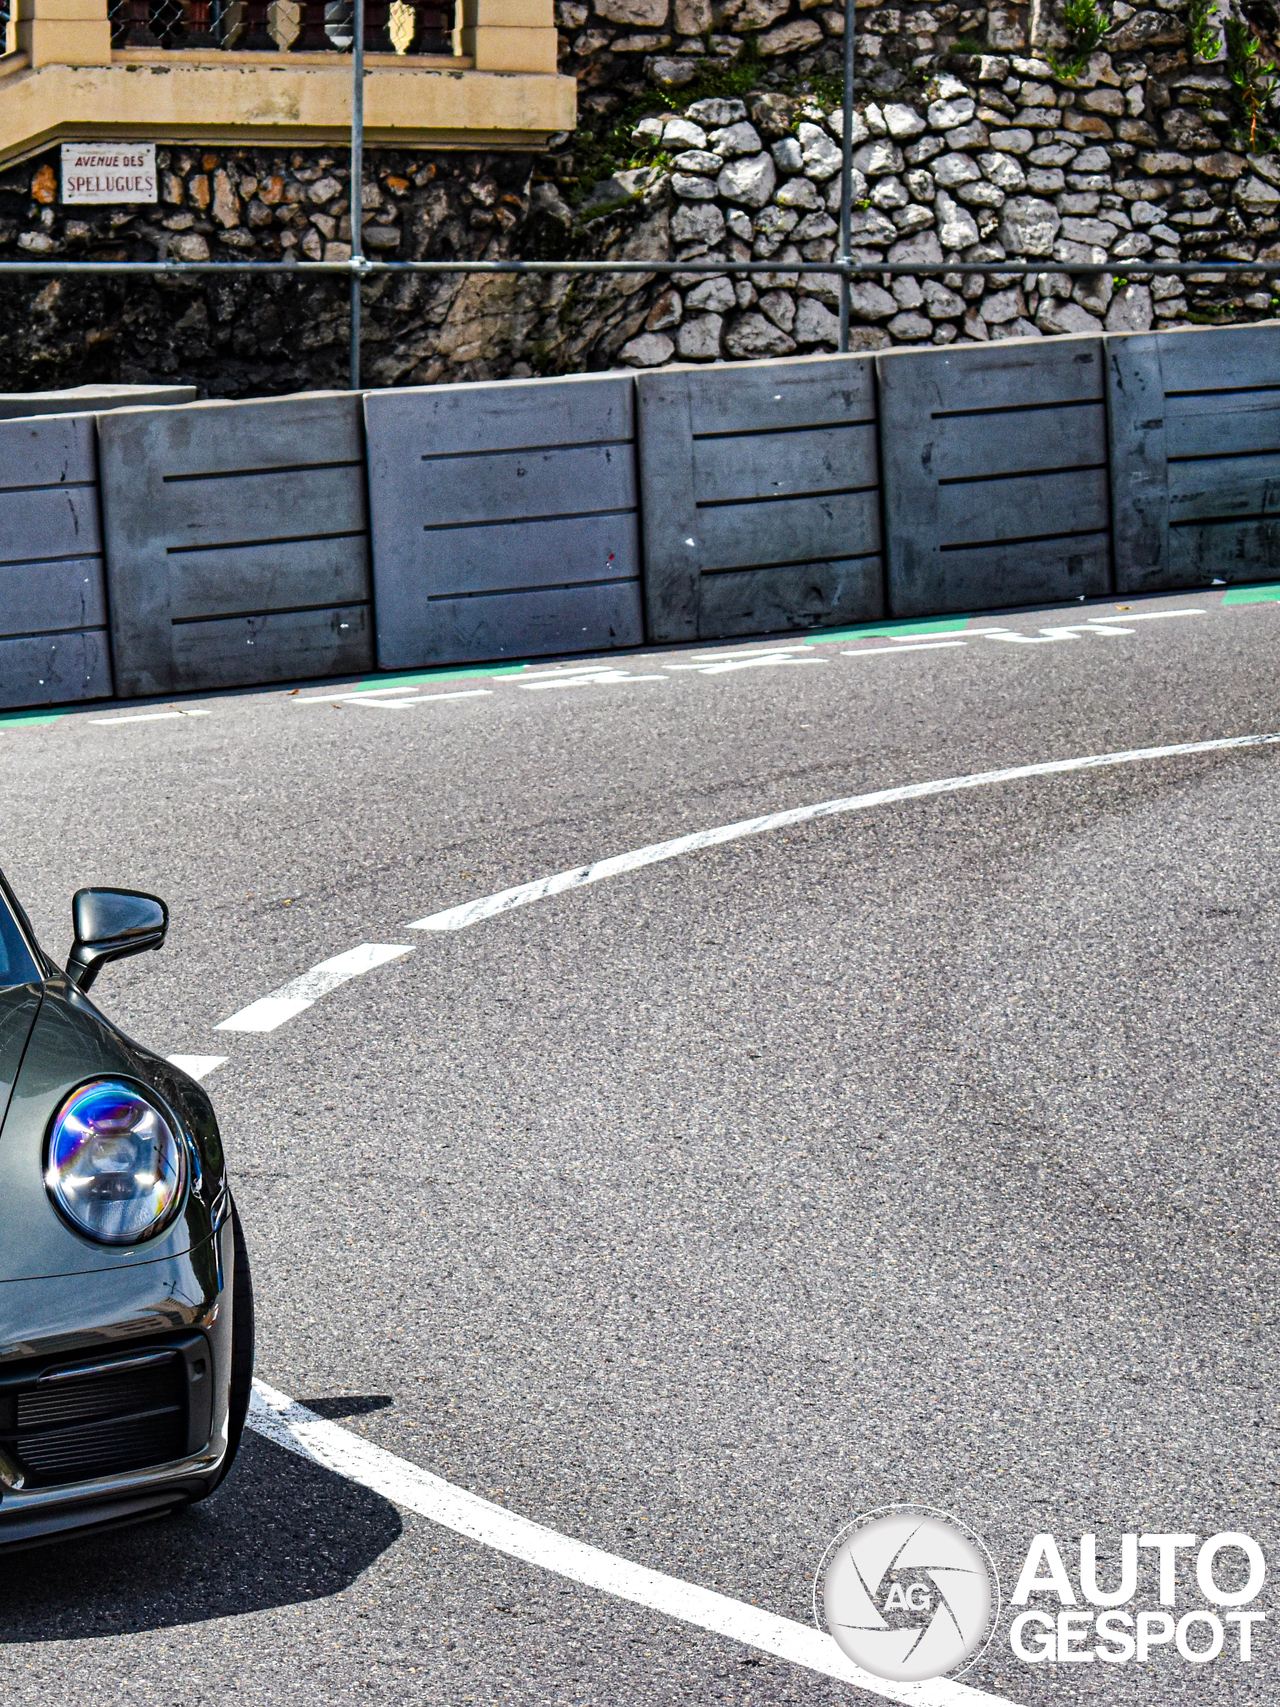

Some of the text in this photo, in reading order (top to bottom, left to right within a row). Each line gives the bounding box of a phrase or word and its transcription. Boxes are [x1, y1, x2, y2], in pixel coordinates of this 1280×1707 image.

[75, 156, 144, 167] AVENUE DES
[67, 176, 153, 192] SPELUGUES
